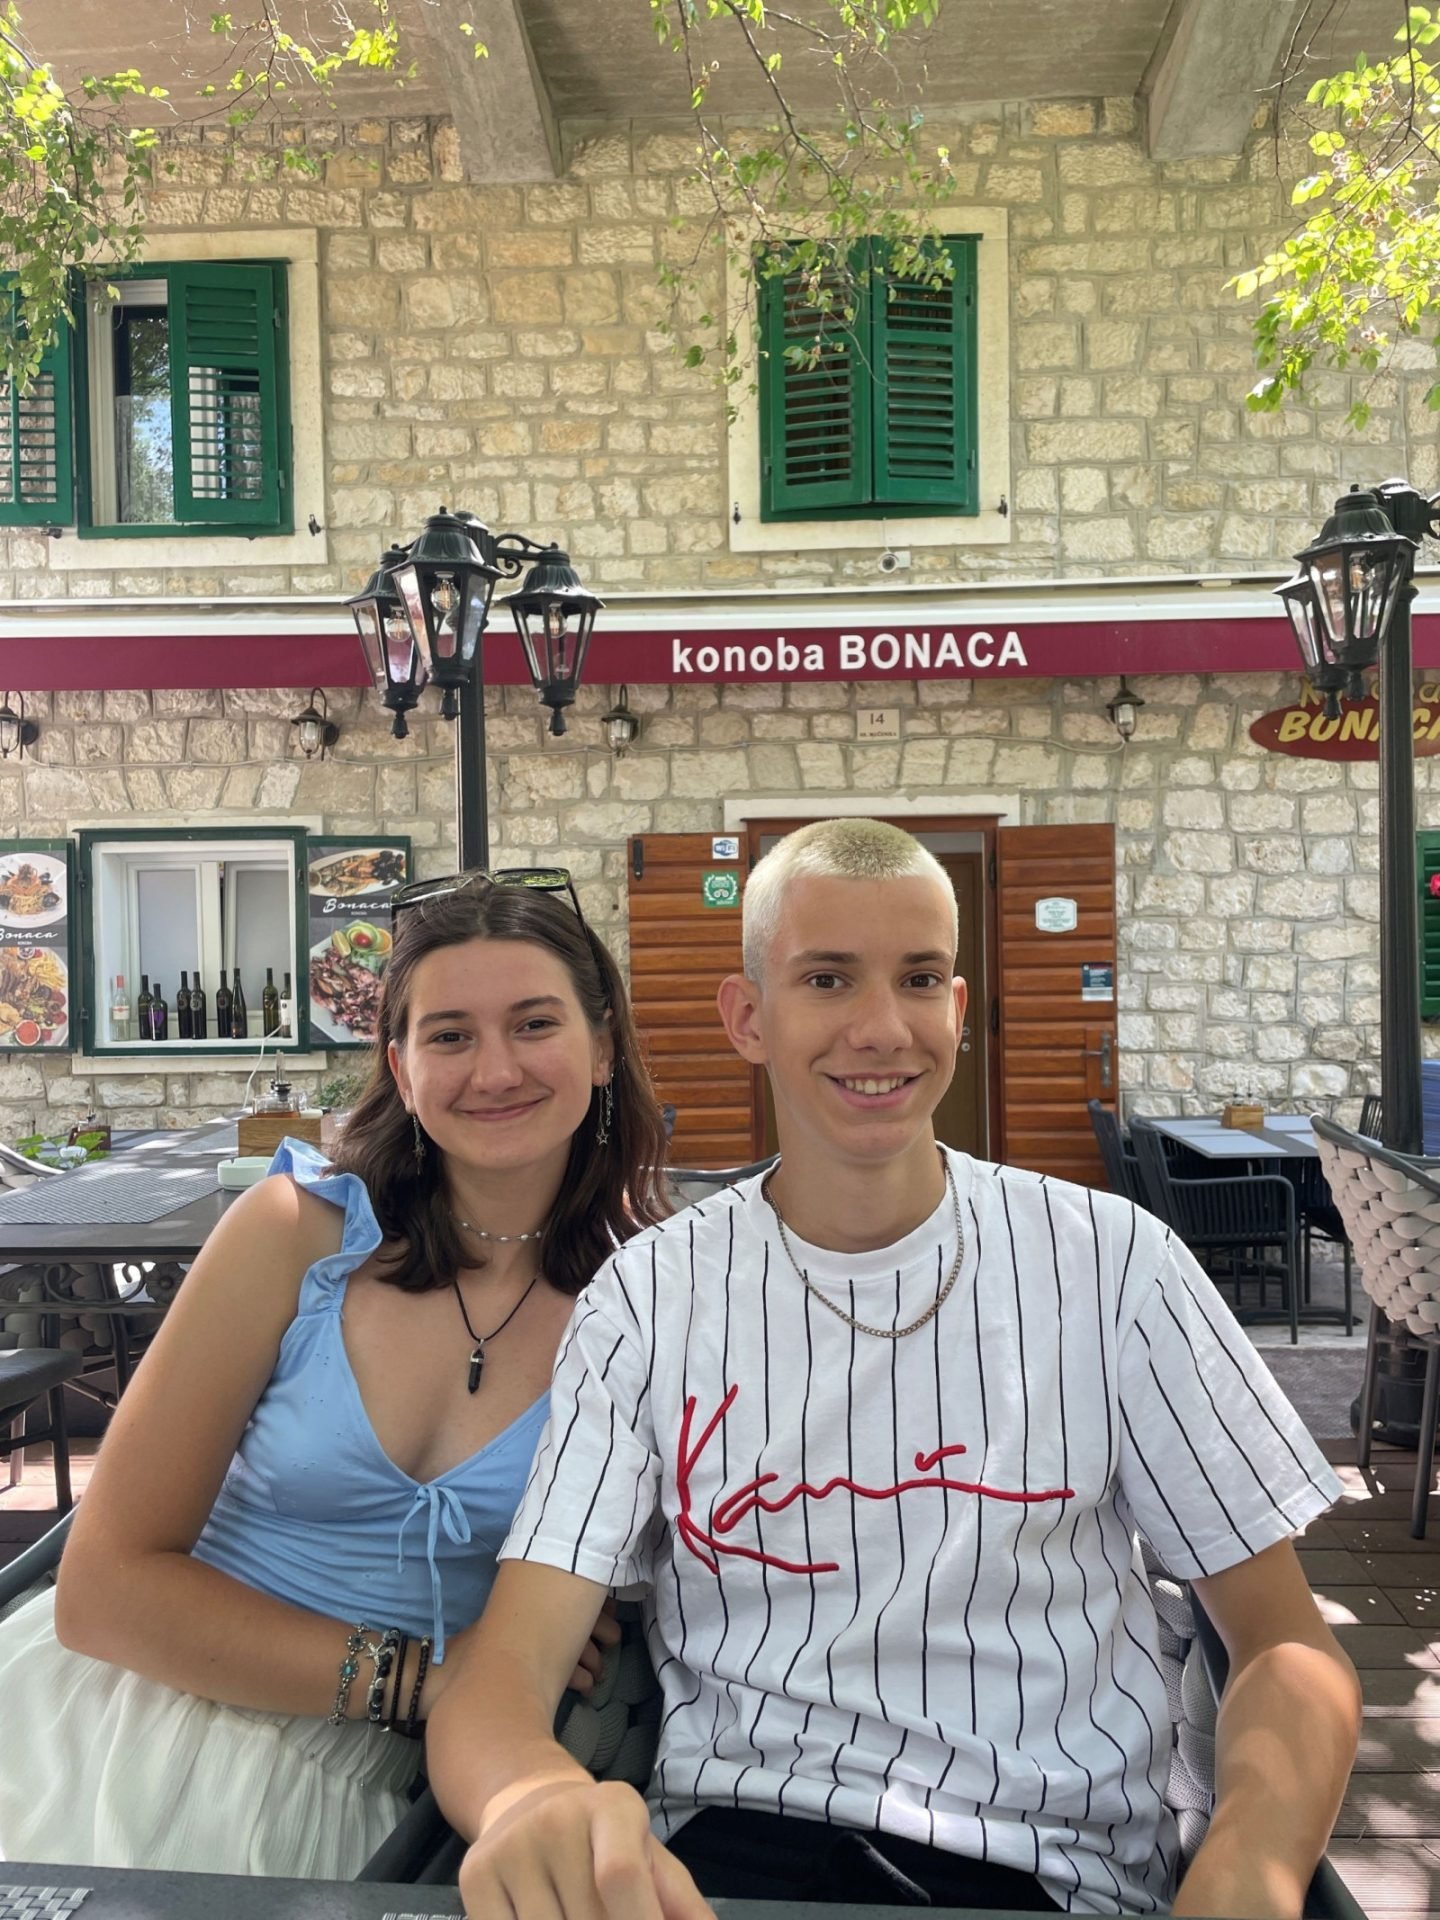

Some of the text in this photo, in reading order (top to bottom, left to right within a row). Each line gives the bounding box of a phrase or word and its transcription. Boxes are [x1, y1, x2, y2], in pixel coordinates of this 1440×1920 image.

[672, 631, 1029, 673] konoba BONACA
[870, 713, 885, 725] 14
[1277, 707, 1440, 742] BONC
[322, 898, 391, 914] Bonaca
